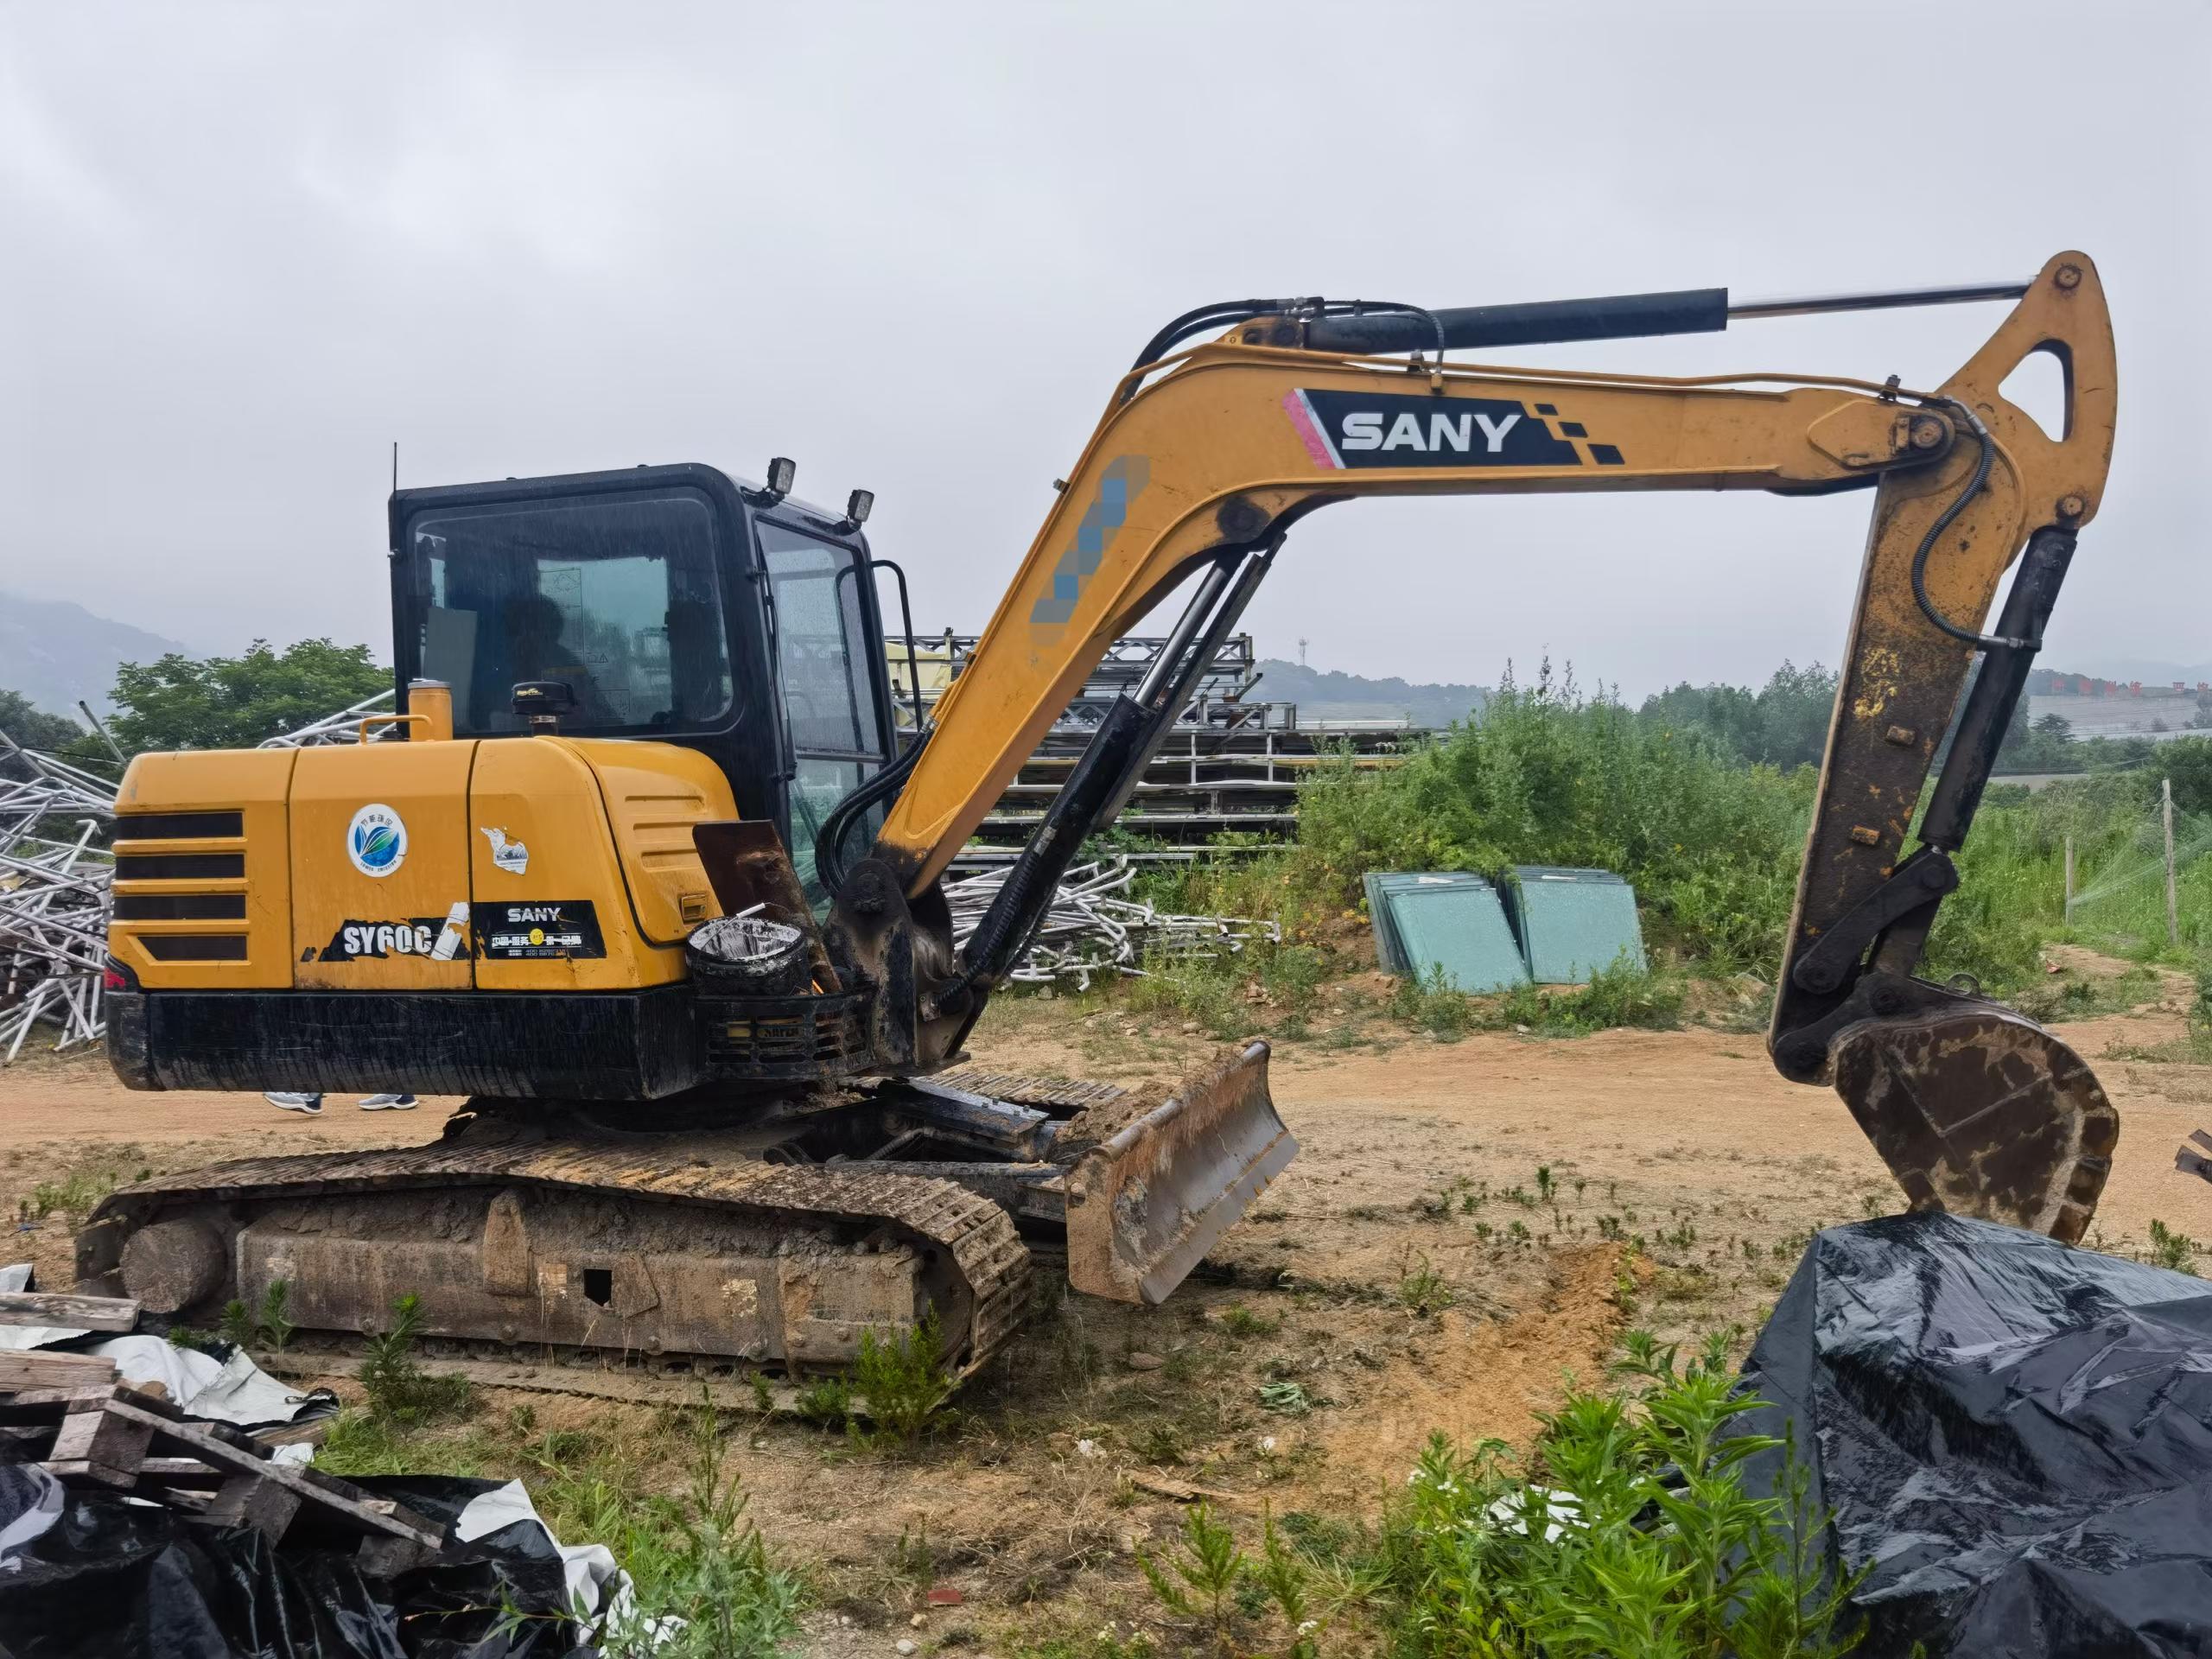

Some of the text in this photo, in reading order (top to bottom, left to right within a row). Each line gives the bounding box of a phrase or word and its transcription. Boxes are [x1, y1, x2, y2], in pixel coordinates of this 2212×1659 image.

[1341, 412, 1522, 453] SANY
[507, 907, 562, 922] SANY
[344, 925, 432, 954] SY60C
